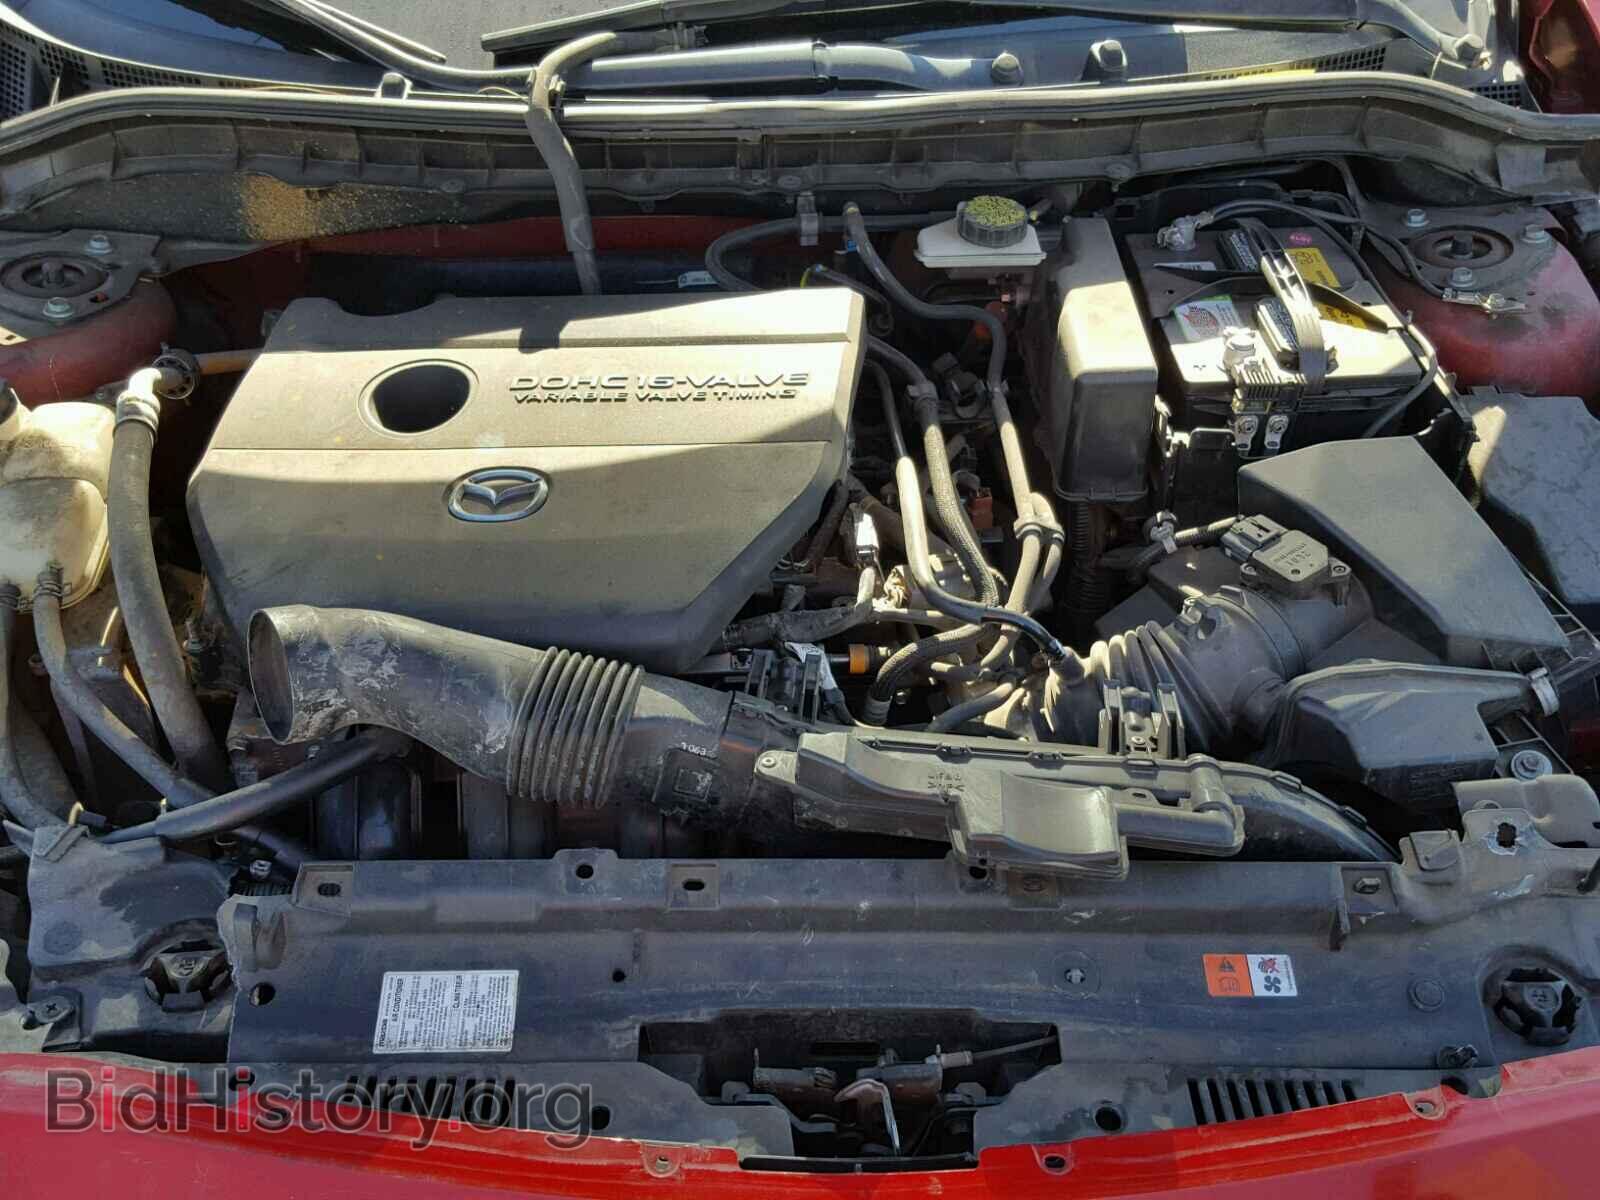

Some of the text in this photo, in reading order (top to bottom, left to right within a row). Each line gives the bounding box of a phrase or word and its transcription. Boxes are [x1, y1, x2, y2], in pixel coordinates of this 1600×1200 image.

[509, 372, 809, 391] DOHC 16-VALVE
[514, 387, 798, 404] VARIABLE VALVE TIMING
